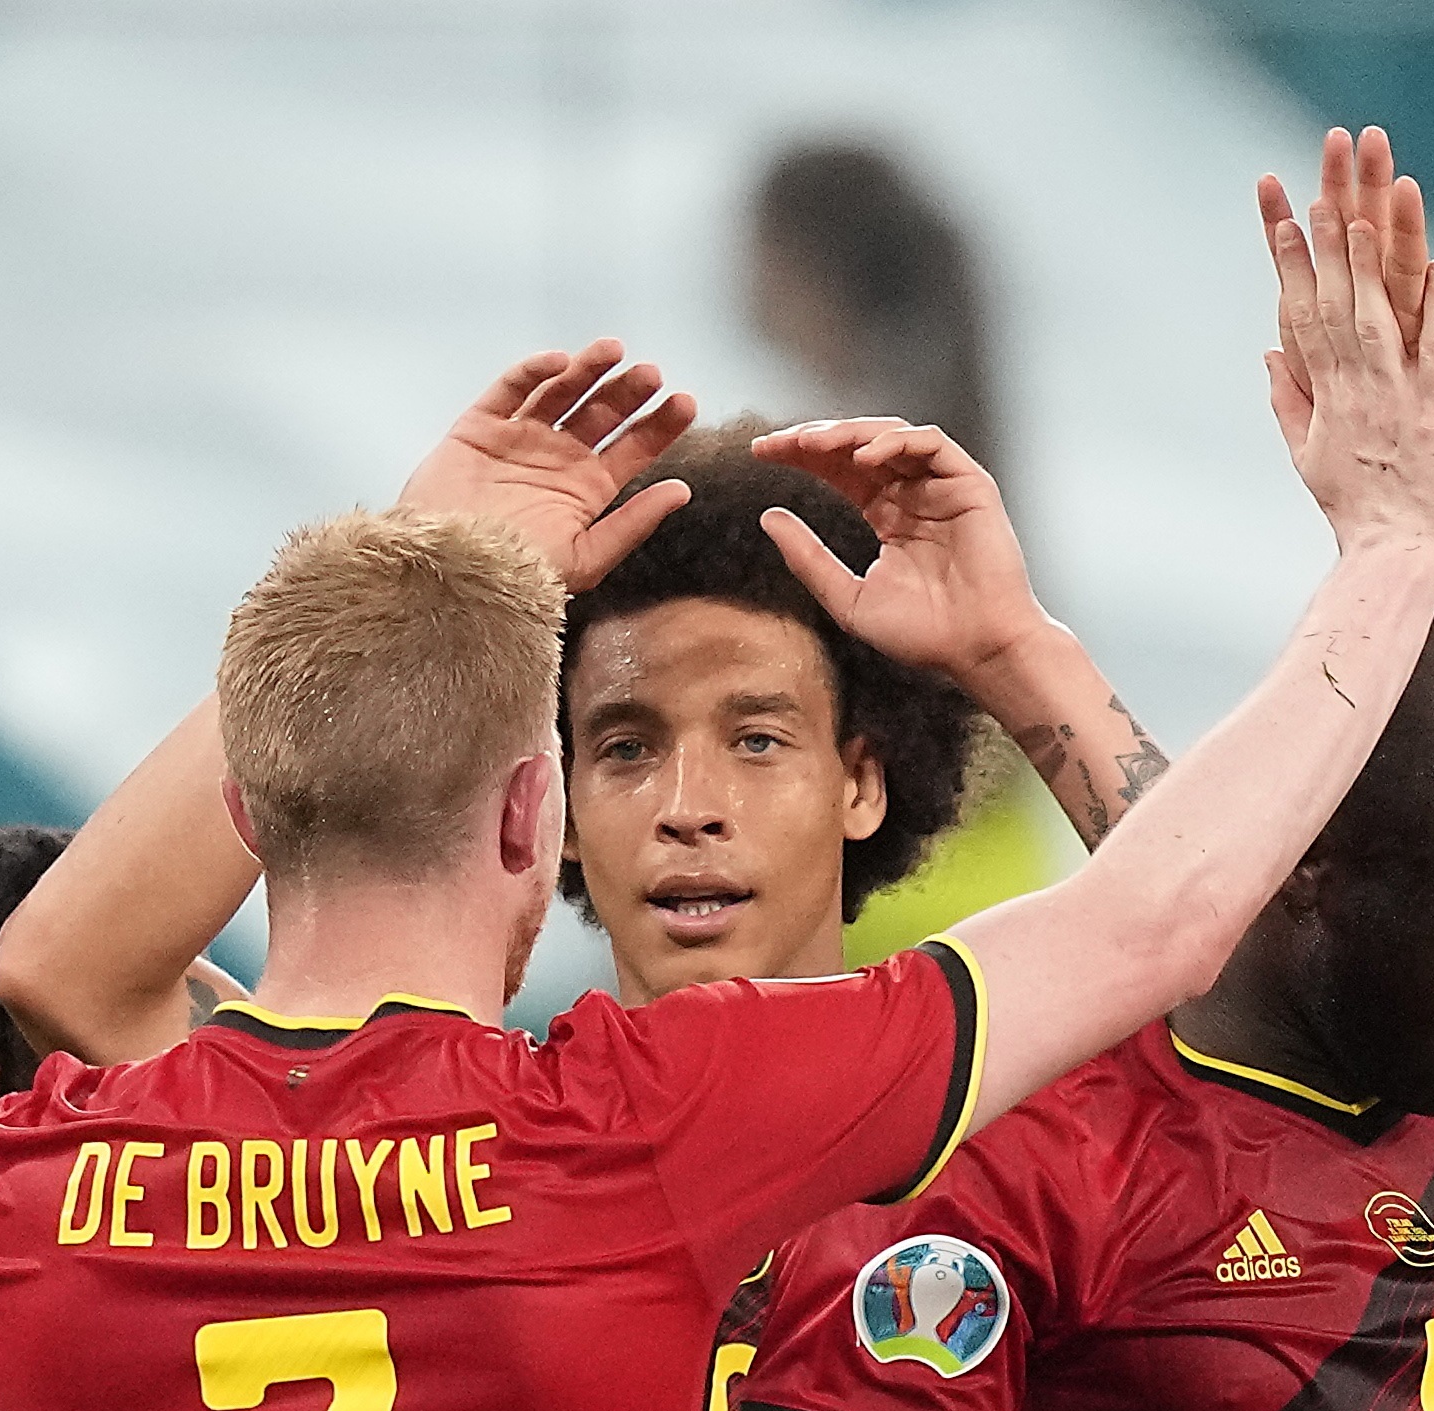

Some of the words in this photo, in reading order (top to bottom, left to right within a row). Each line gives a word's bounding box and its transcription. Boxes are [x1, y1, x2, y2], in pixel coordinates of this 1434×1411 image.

[57, 1141, 165, 1247] DE
[186, 1122, 513, 1250] BRUYNE
[1216, 1254, 1302, 1283] adidas
